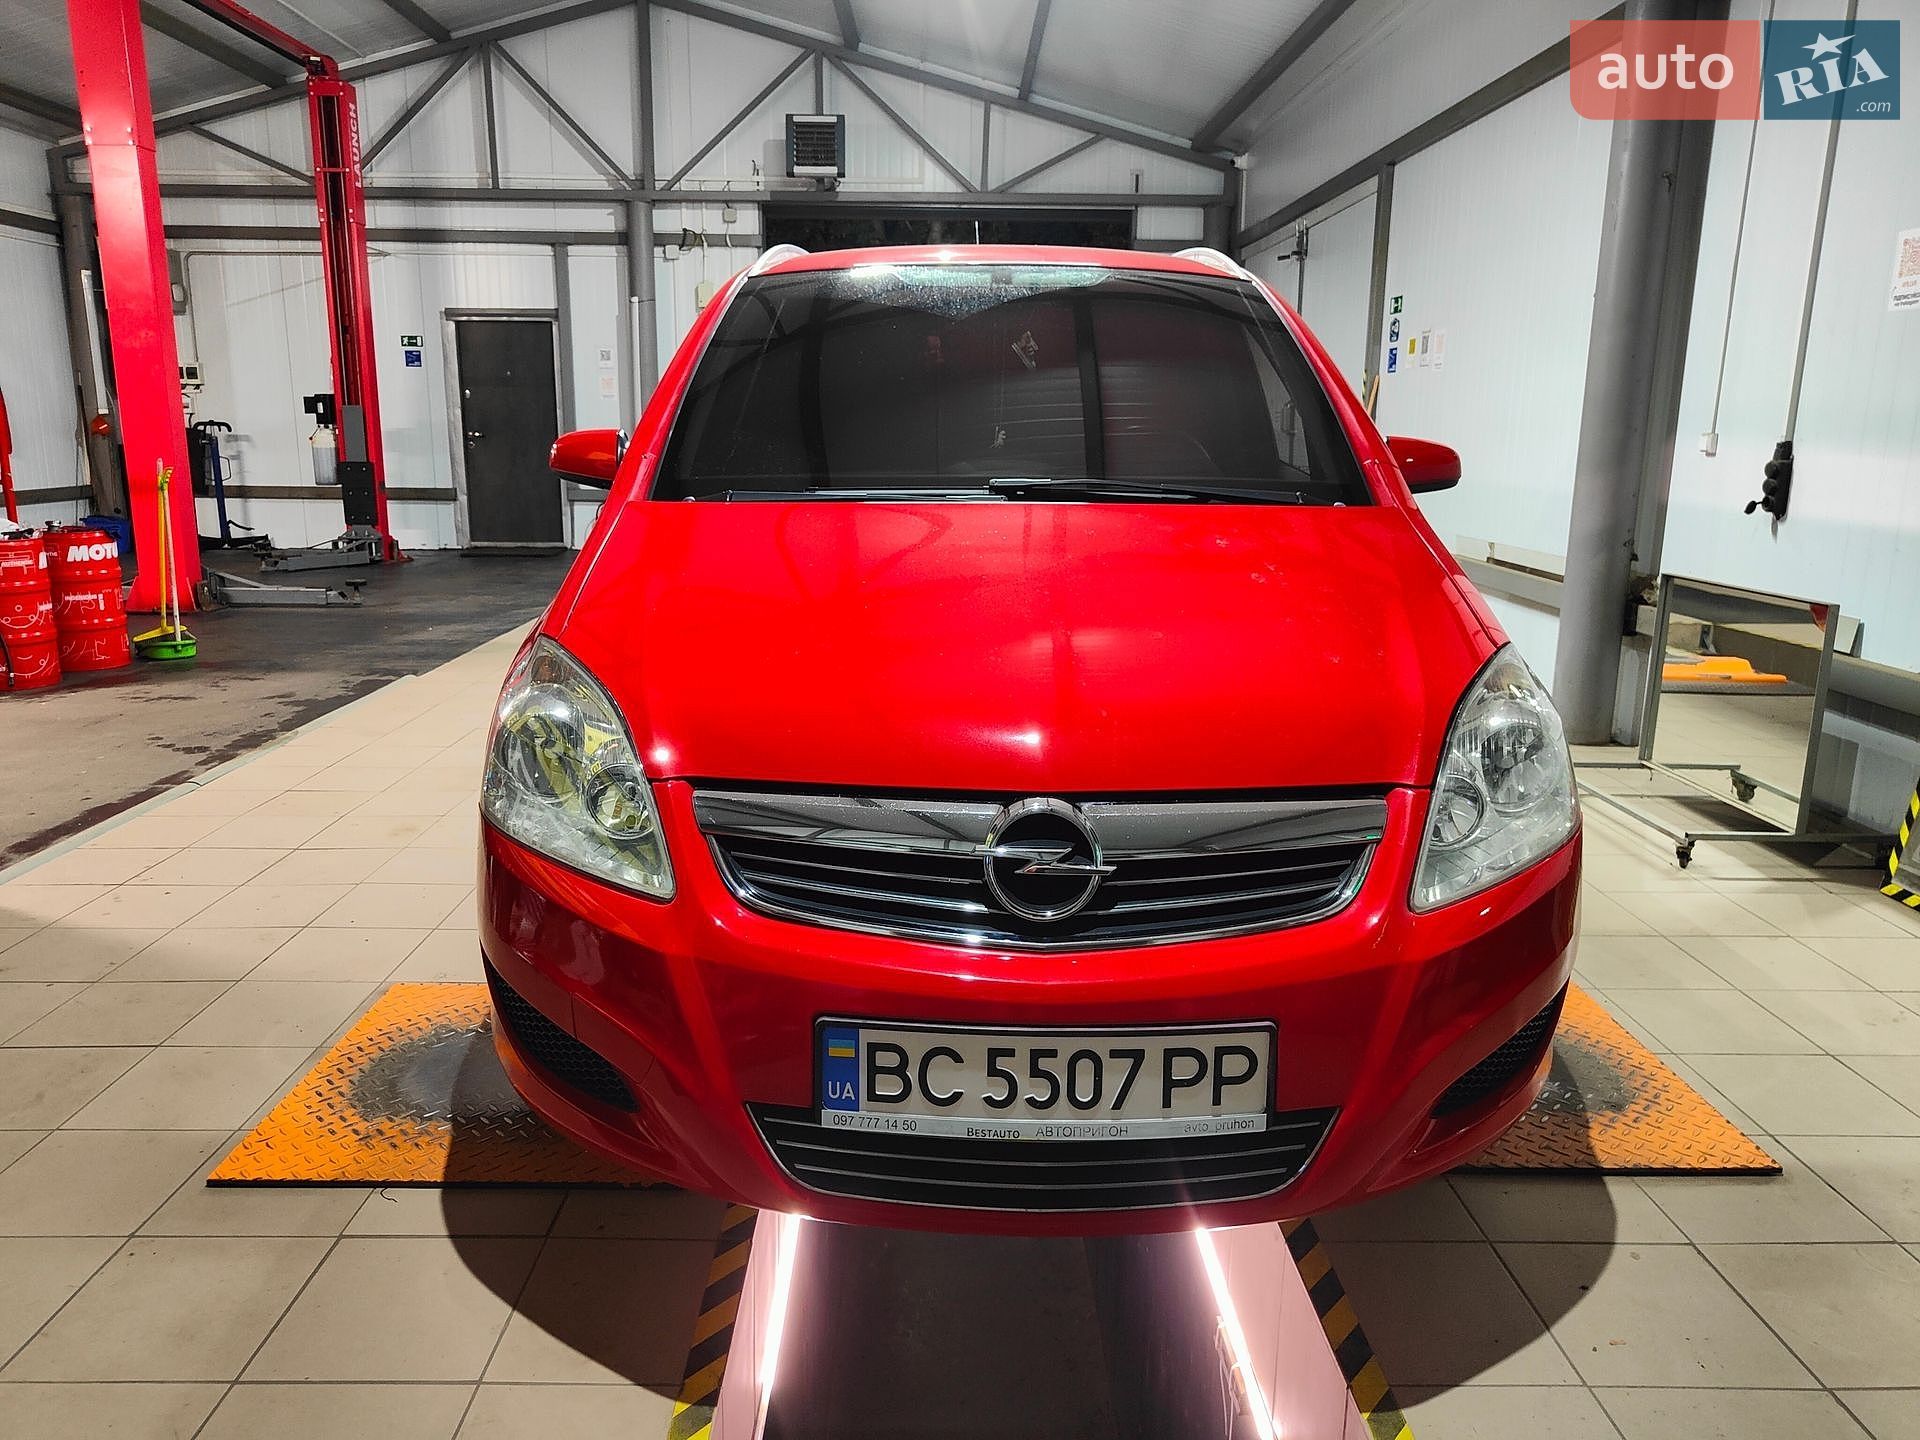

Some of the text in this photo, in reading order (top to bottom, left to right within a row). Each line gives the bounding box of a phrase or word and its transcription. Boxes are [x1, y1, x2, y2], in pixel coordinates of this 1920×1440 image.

[348, 102, 362, 188] LAUNCH
[866, 1042, 1259, 1111] BC 5507 PP
[828, 1080, 856, 1101] UA
[832, 1114, 918, 1132] 097 777 14 50
[1035, 1125, 1129, 1138] АВТОПРИГОН
